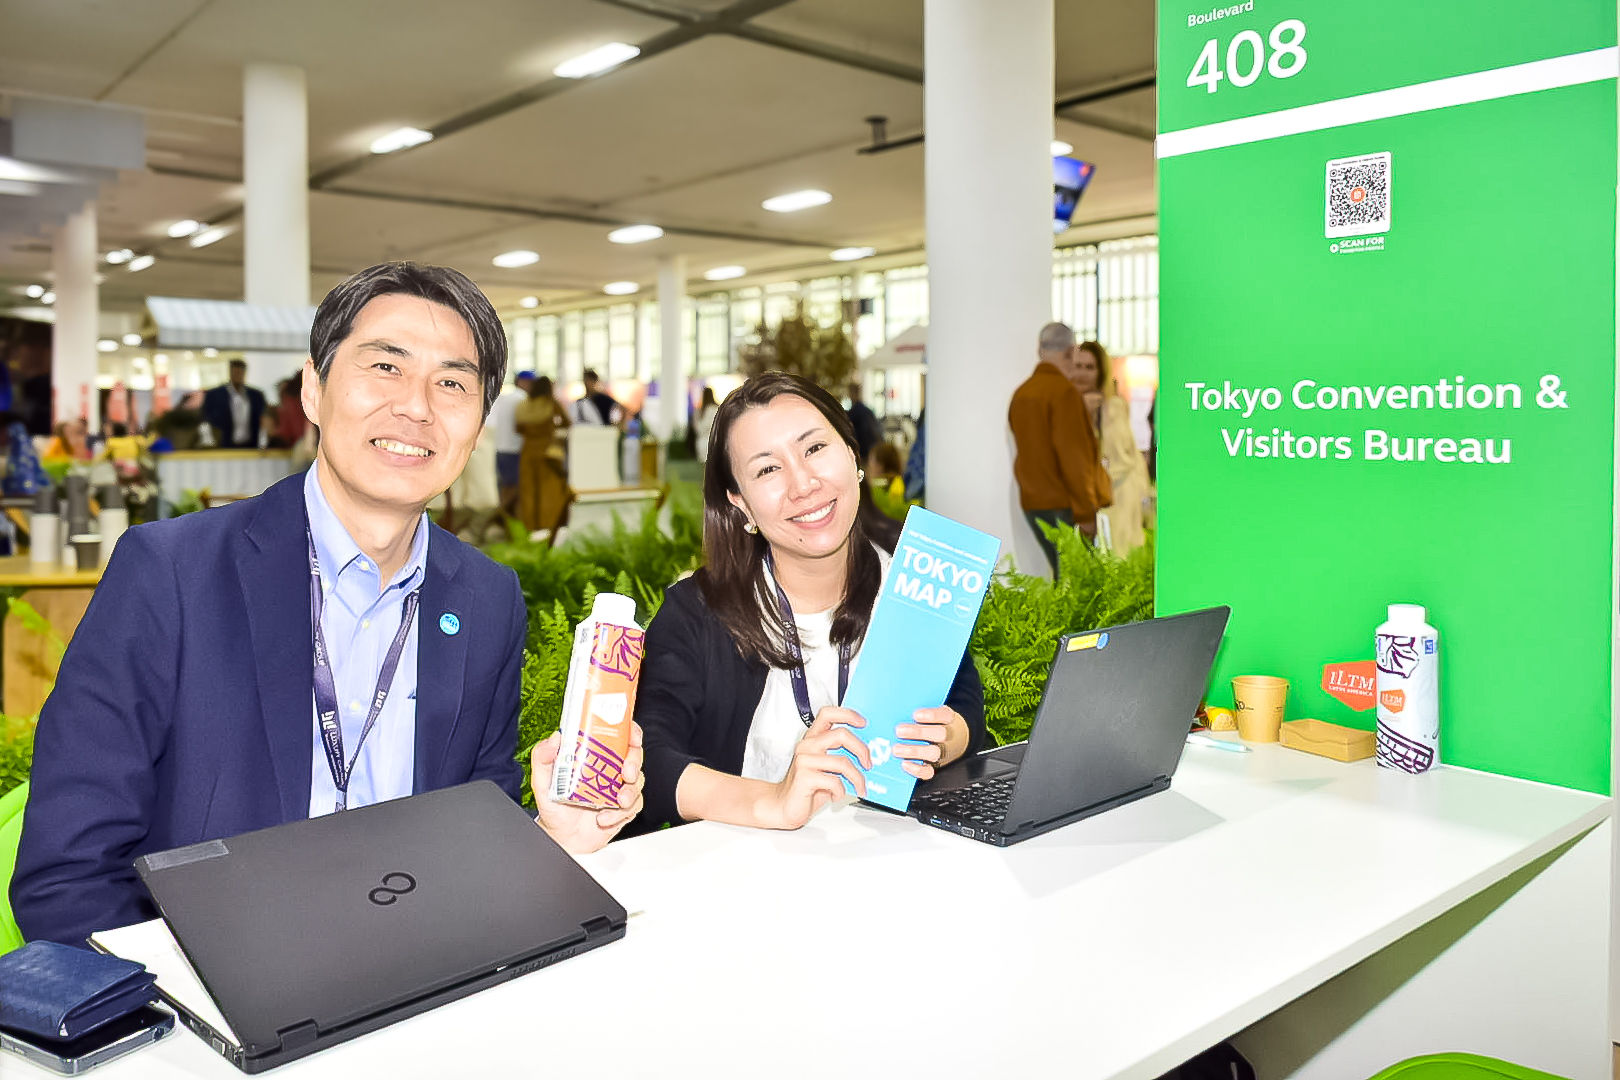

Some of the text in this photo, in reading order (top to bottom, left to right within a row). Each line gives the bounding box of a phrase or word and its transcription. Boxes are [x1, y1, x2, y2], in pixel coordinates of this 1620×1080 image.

[1187, 0, 1254, 27] Boulevard
[1187, 19, 1307, 94] 408
[1365, 236, 1385, 247] FOR
[1185, 374, 1569, 418] Tokyo Convention &
[1222, 428, 1512, 464] Visitors Bureau
[903, 545, 983, 594] TOKYO
[893, 572, 953, 609] MAP
